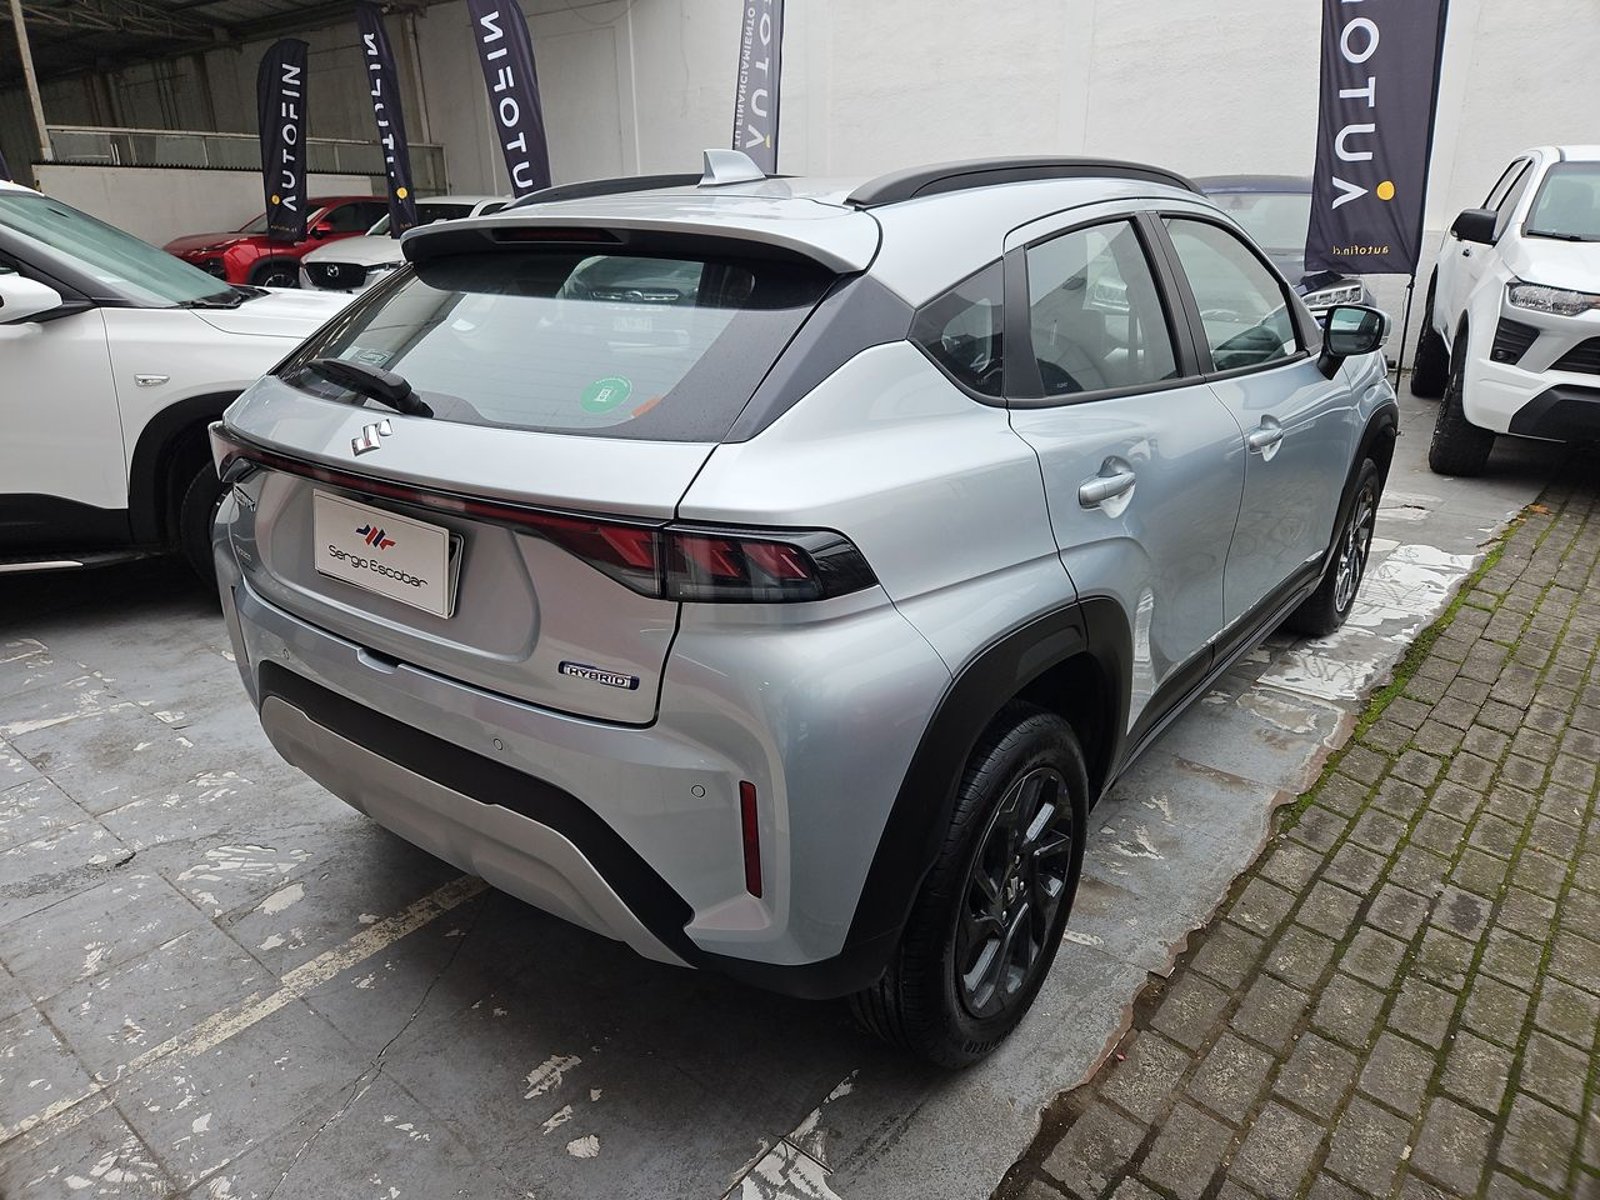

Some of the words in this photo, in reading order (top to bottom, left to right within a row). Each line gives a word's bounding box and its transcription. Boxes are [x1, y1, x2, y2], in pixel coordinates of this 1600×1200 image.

[281, 63, 301, 212] AUTOFIN
[369, 560, 428, 588] Escobar
[568, 666, 626, 686] HYBRID
